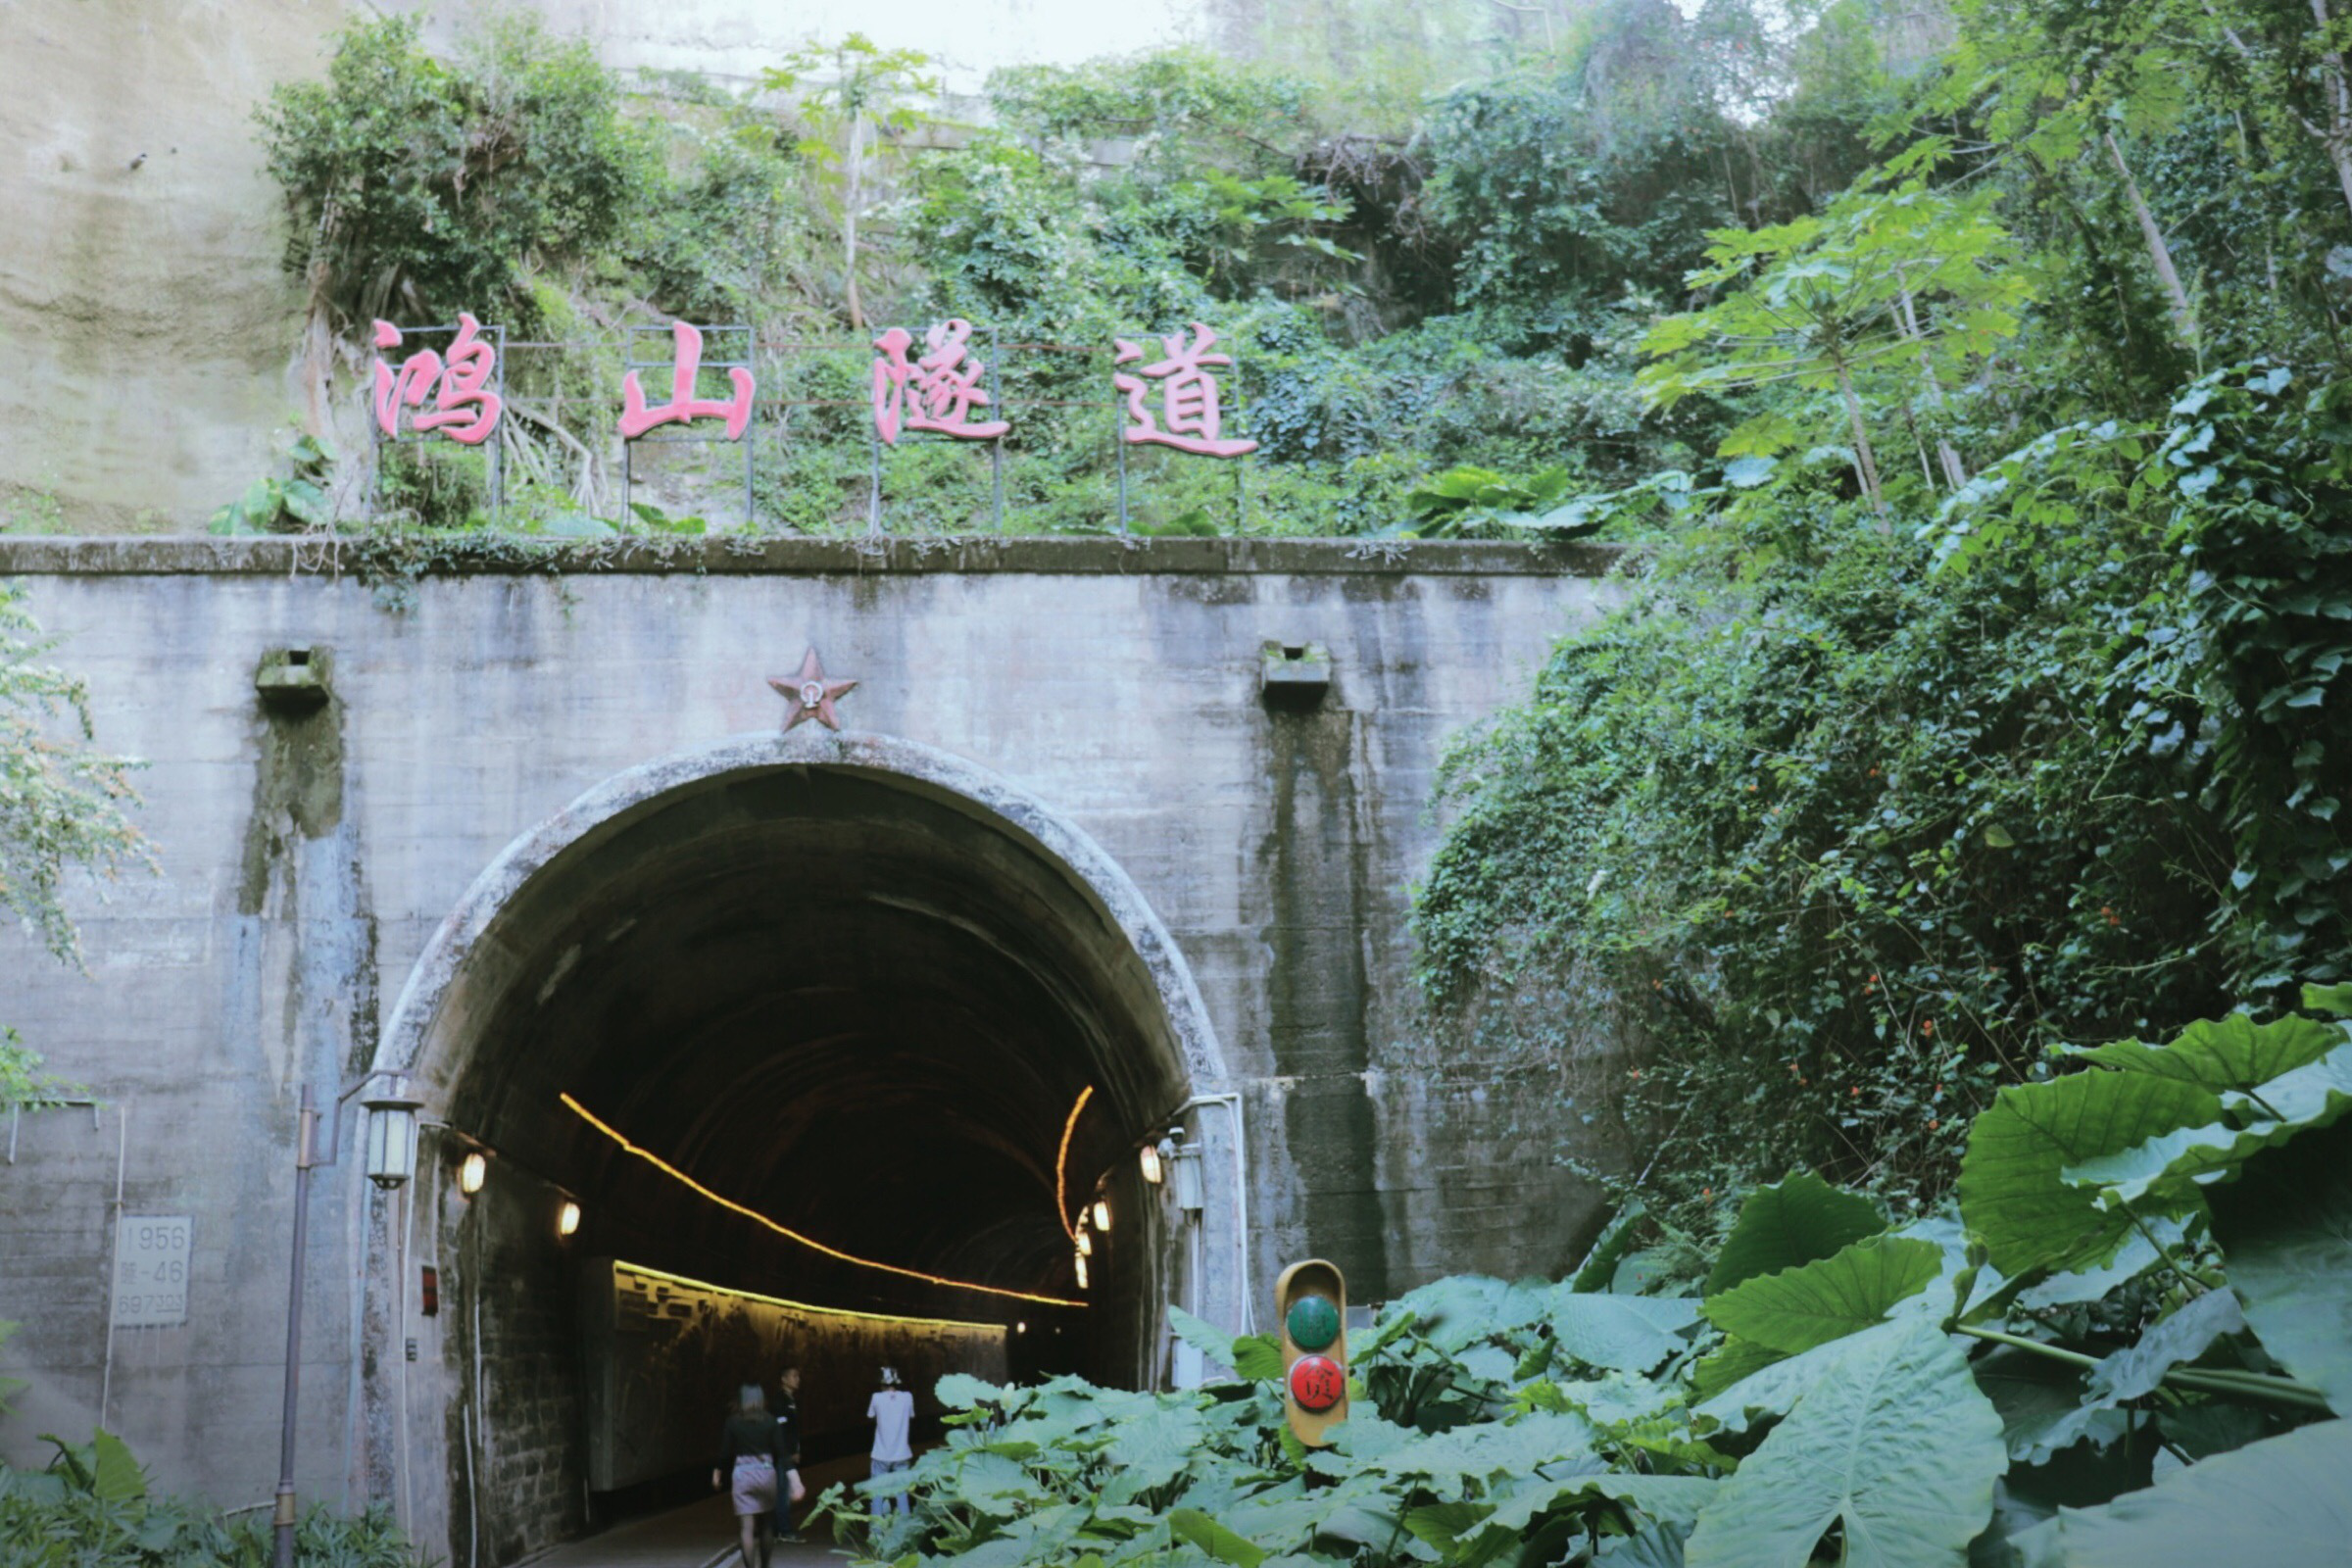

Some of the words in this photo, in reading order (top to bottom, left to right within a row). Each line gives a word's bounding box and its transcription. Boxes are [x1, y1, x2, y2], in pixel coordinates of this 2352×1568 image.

[373, 312, 1258, 457] 鸿山隧道
[127, 1226, 185, 1251] 1956
